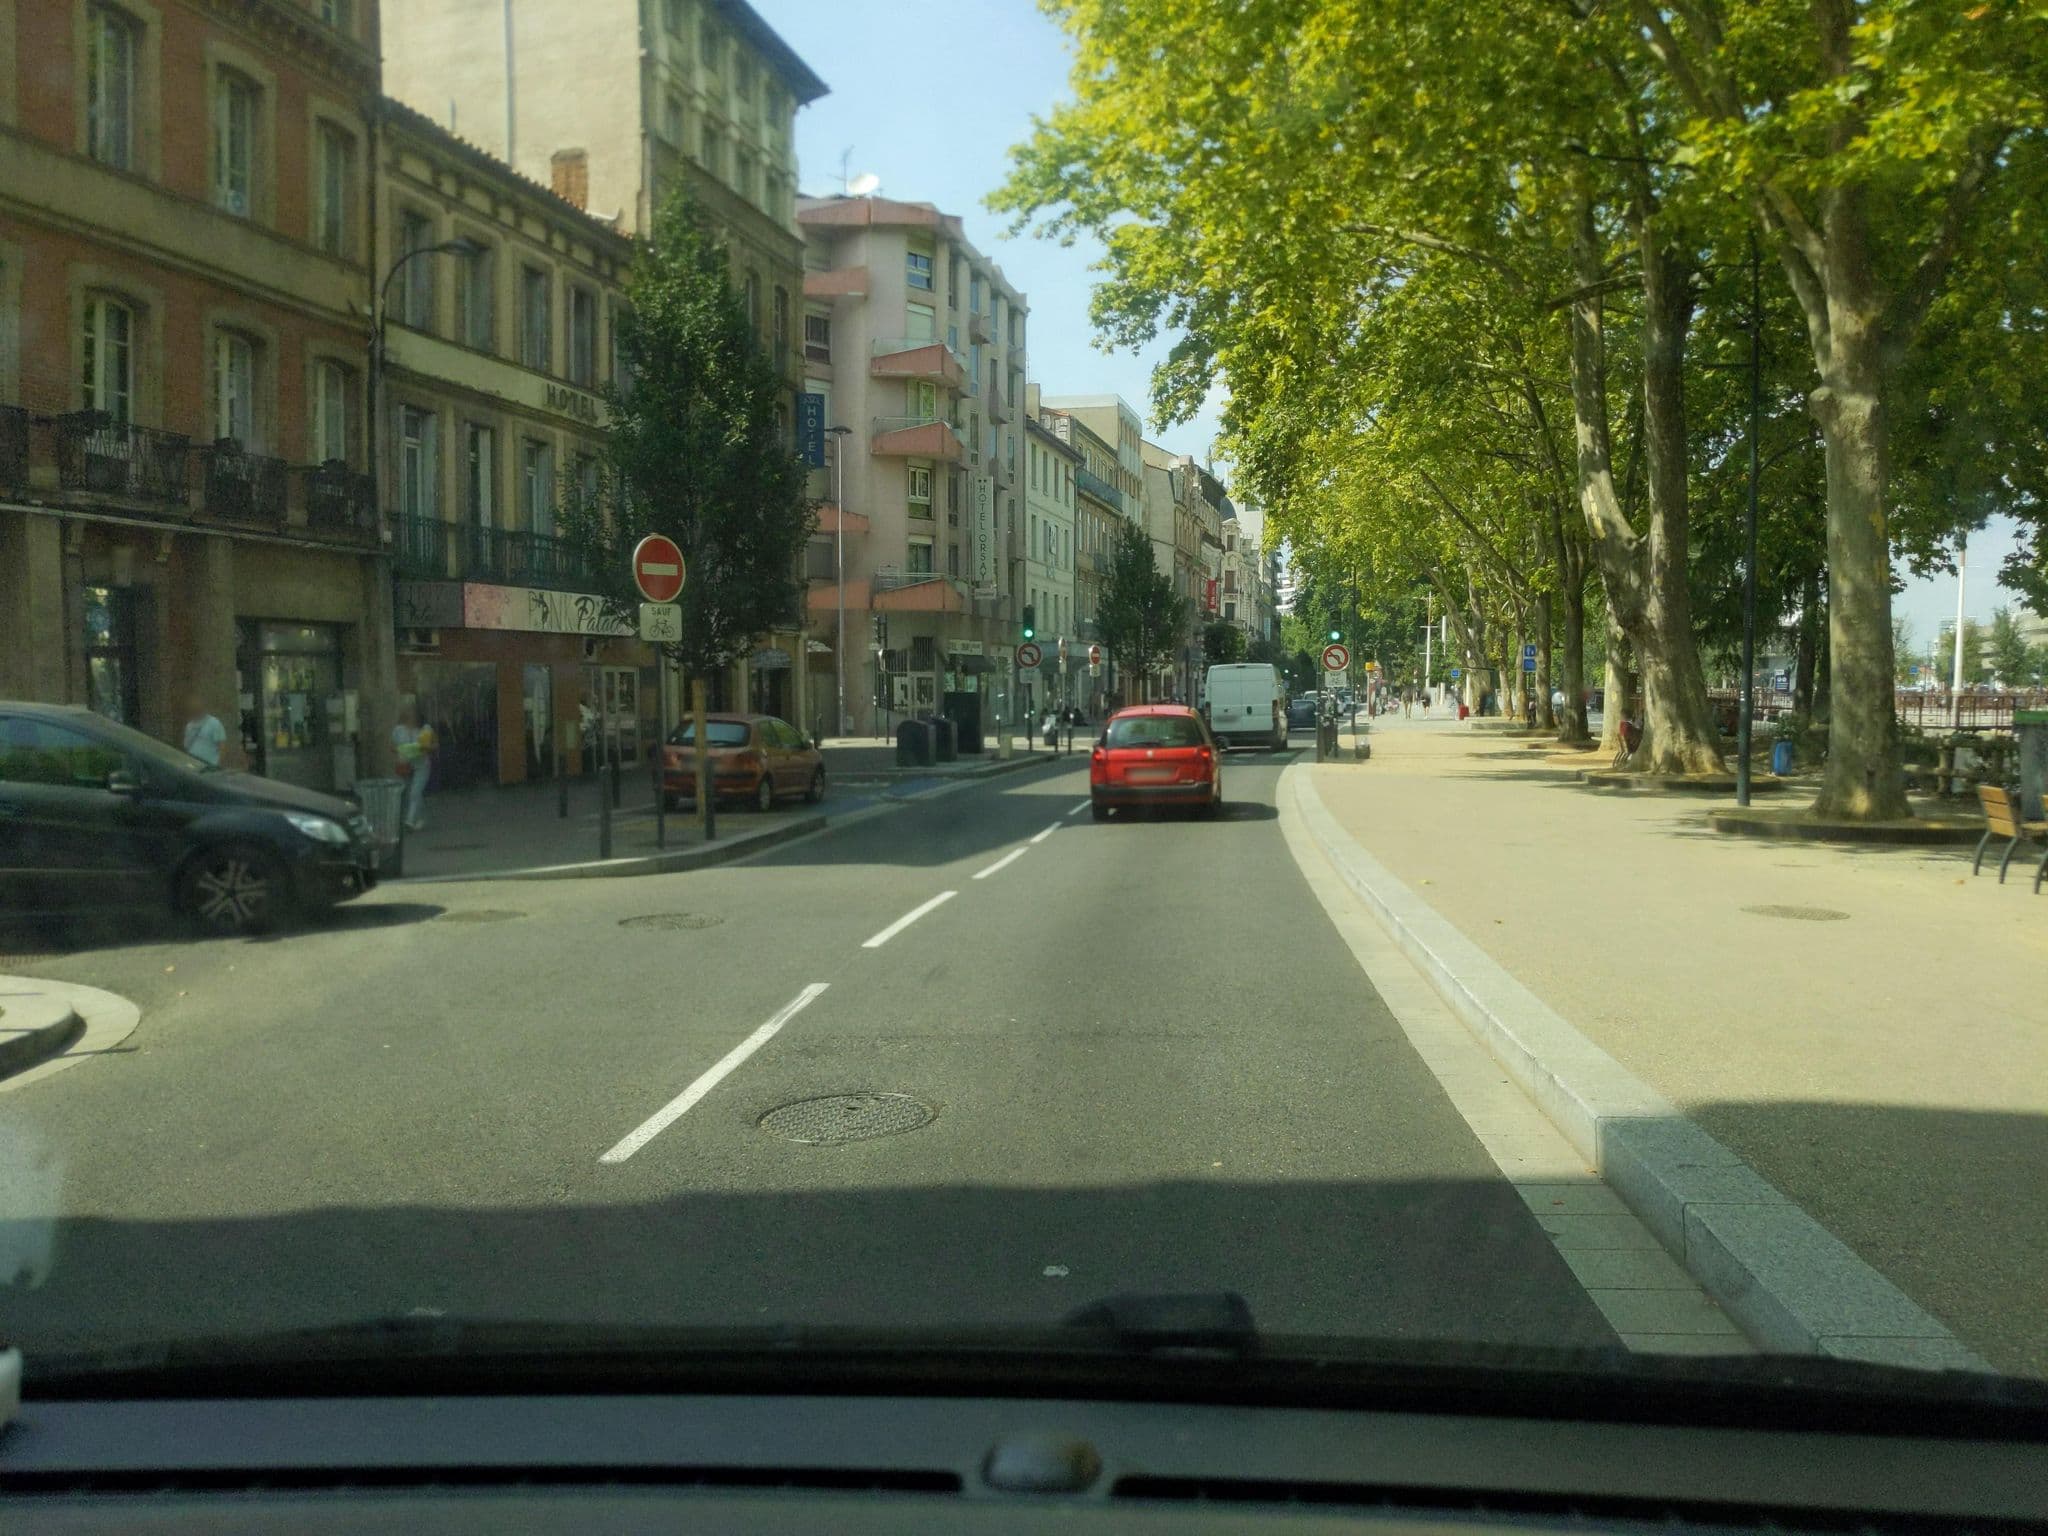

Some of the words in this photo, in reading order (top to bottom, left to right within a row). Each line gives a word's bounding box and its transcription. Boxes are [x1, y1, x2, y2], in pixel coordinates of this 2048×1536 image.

[546, 383, 598, 421] HOTEL
[807, 406, 817, 465] HOTEL
[978, 485, 988, 531] HOTEL
[978, 533, 988, 581] ORSAY
[651, 606, 672, 617] SAUF
